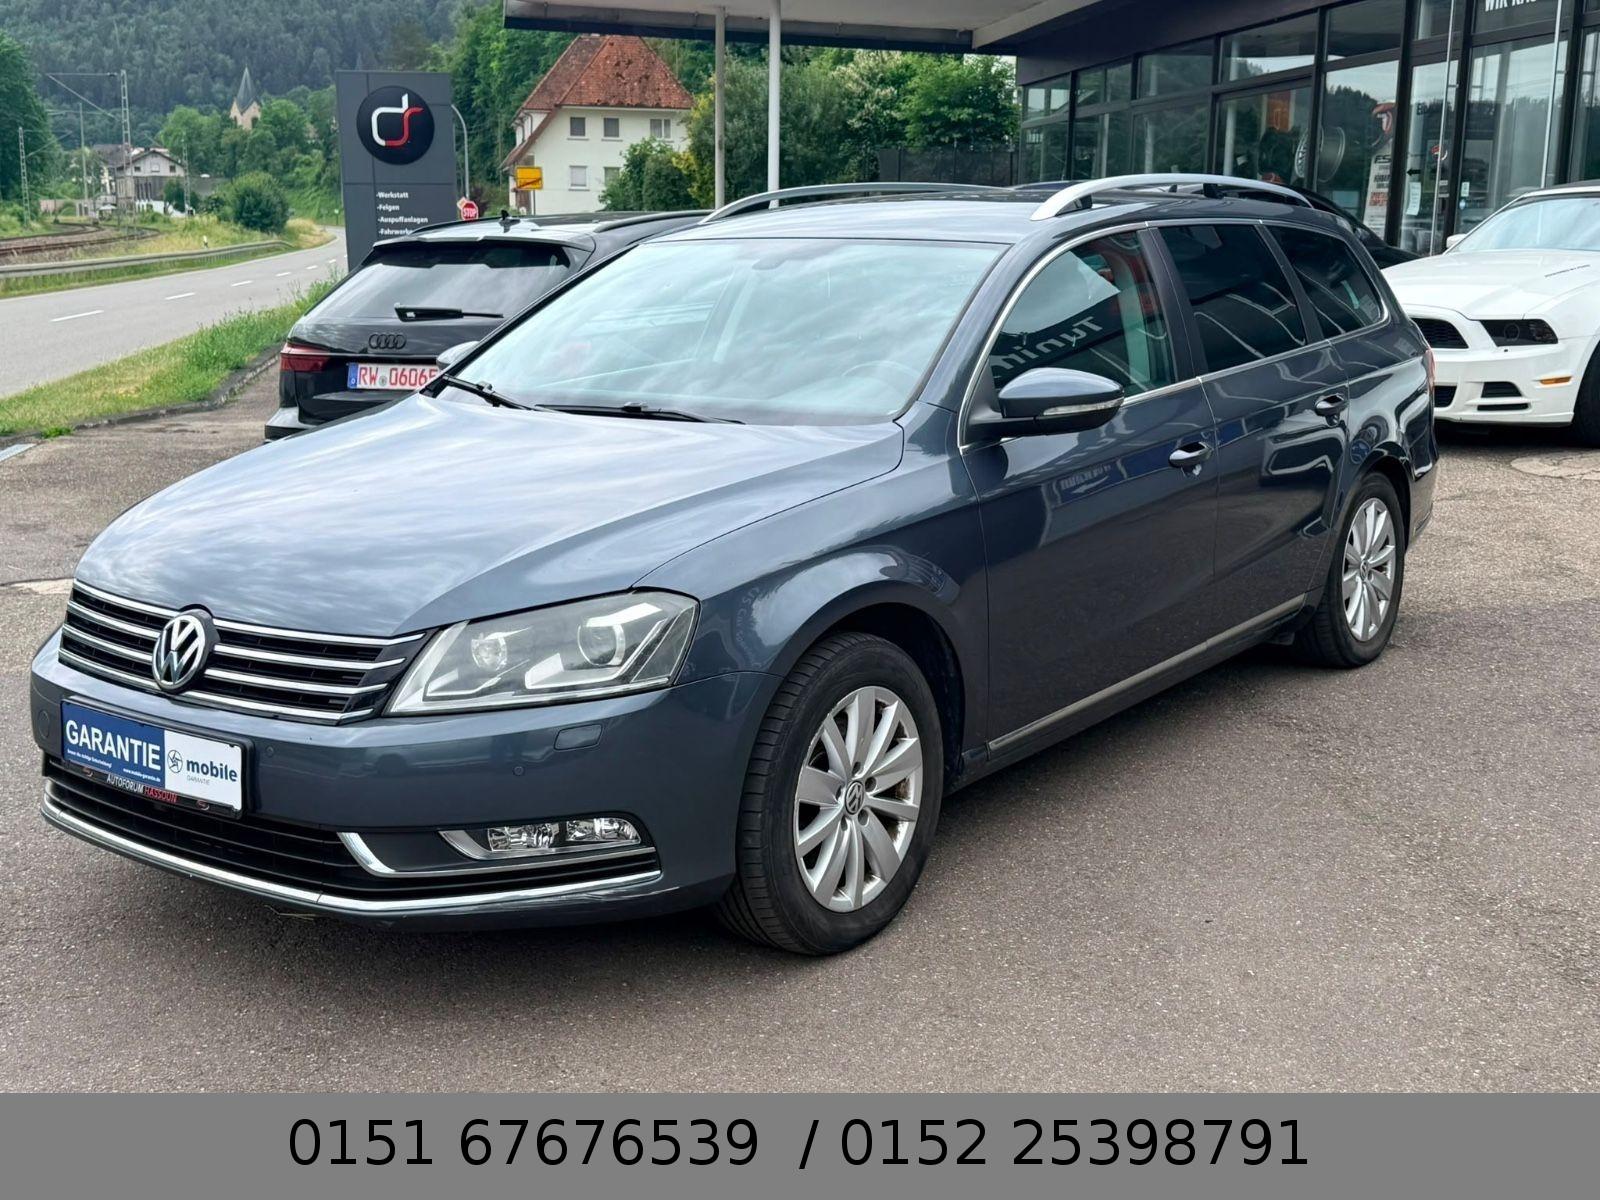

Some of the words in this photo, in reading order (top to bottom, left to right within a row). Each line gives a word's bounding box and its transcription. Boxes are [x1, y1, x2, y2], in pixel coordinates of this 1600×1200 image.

[376, 191, 409, 199] -Werkstatt
[377, 204, 400, 212] -Felgen
[463, 207, 477, 217] STOP
[359, 367, 378, 386] RW
[66, 720, 162, 771] GARANTIE
[186, 759, 238, 782] mobile
[106, 774, 144, 794] AUTOFORUM
[145, 786, 177, 803] HASSOUN
